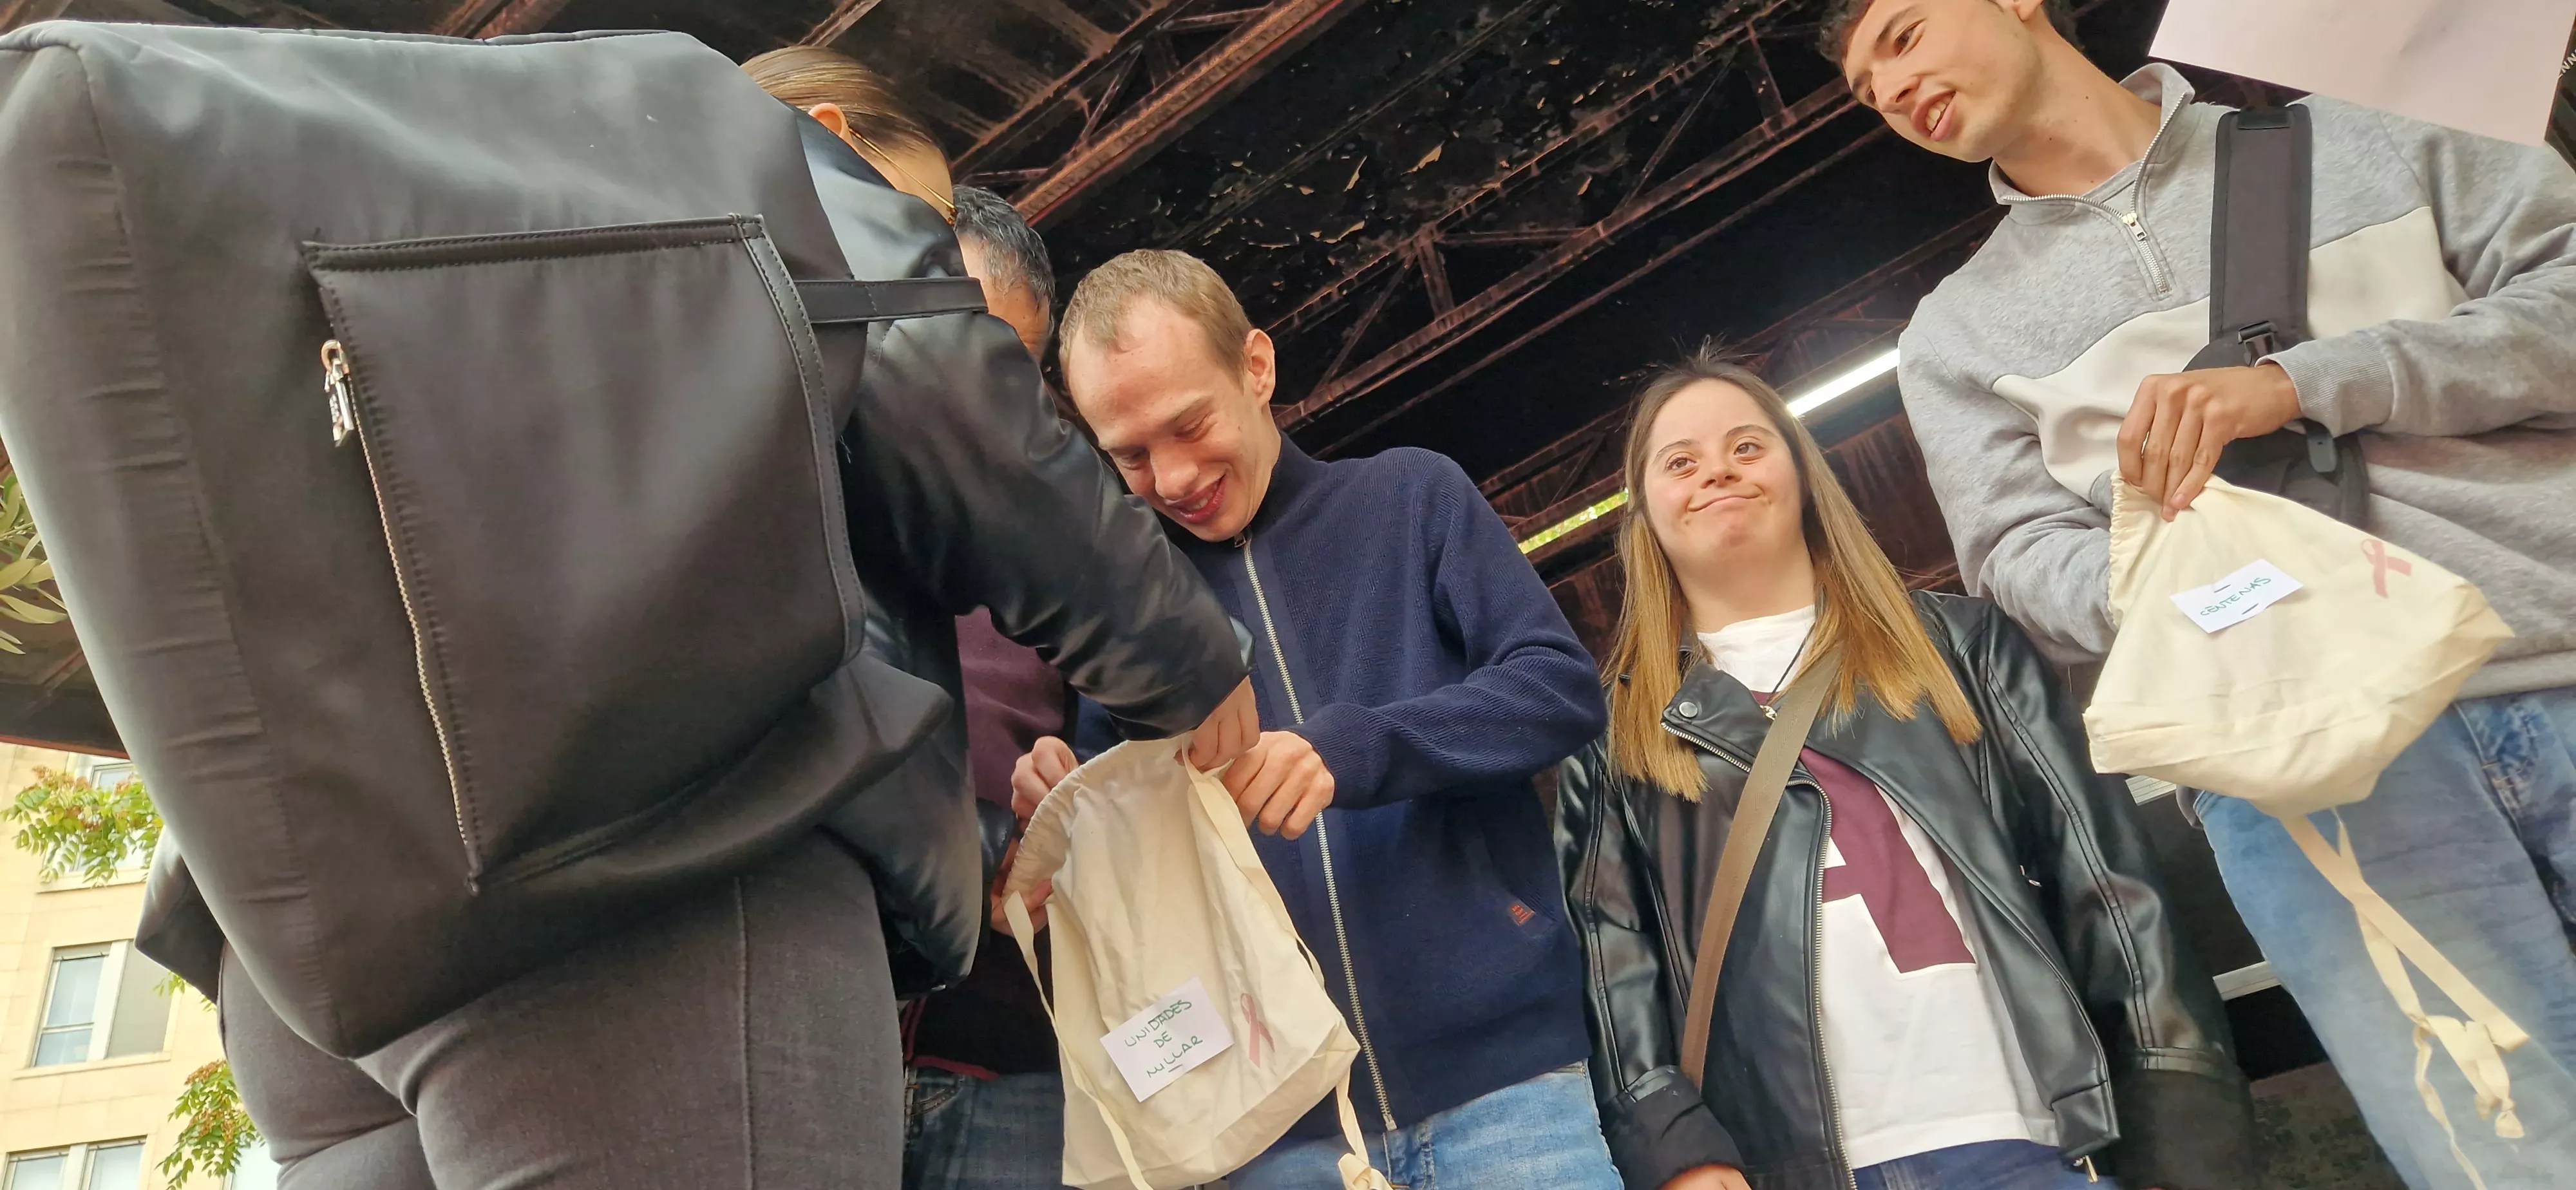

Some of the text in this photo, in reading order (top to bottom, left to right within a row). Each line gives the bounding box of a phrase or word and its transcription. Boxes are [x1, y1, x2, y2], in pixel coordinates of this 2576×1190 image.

[2200, 578, 2271, 616] CENTENAS
[1124, 999, 1192, 1046] UNIDADES
[1153, 1030, 1172, 1048] DE
[1146, 1035, 1203, 1078] MILLAR
